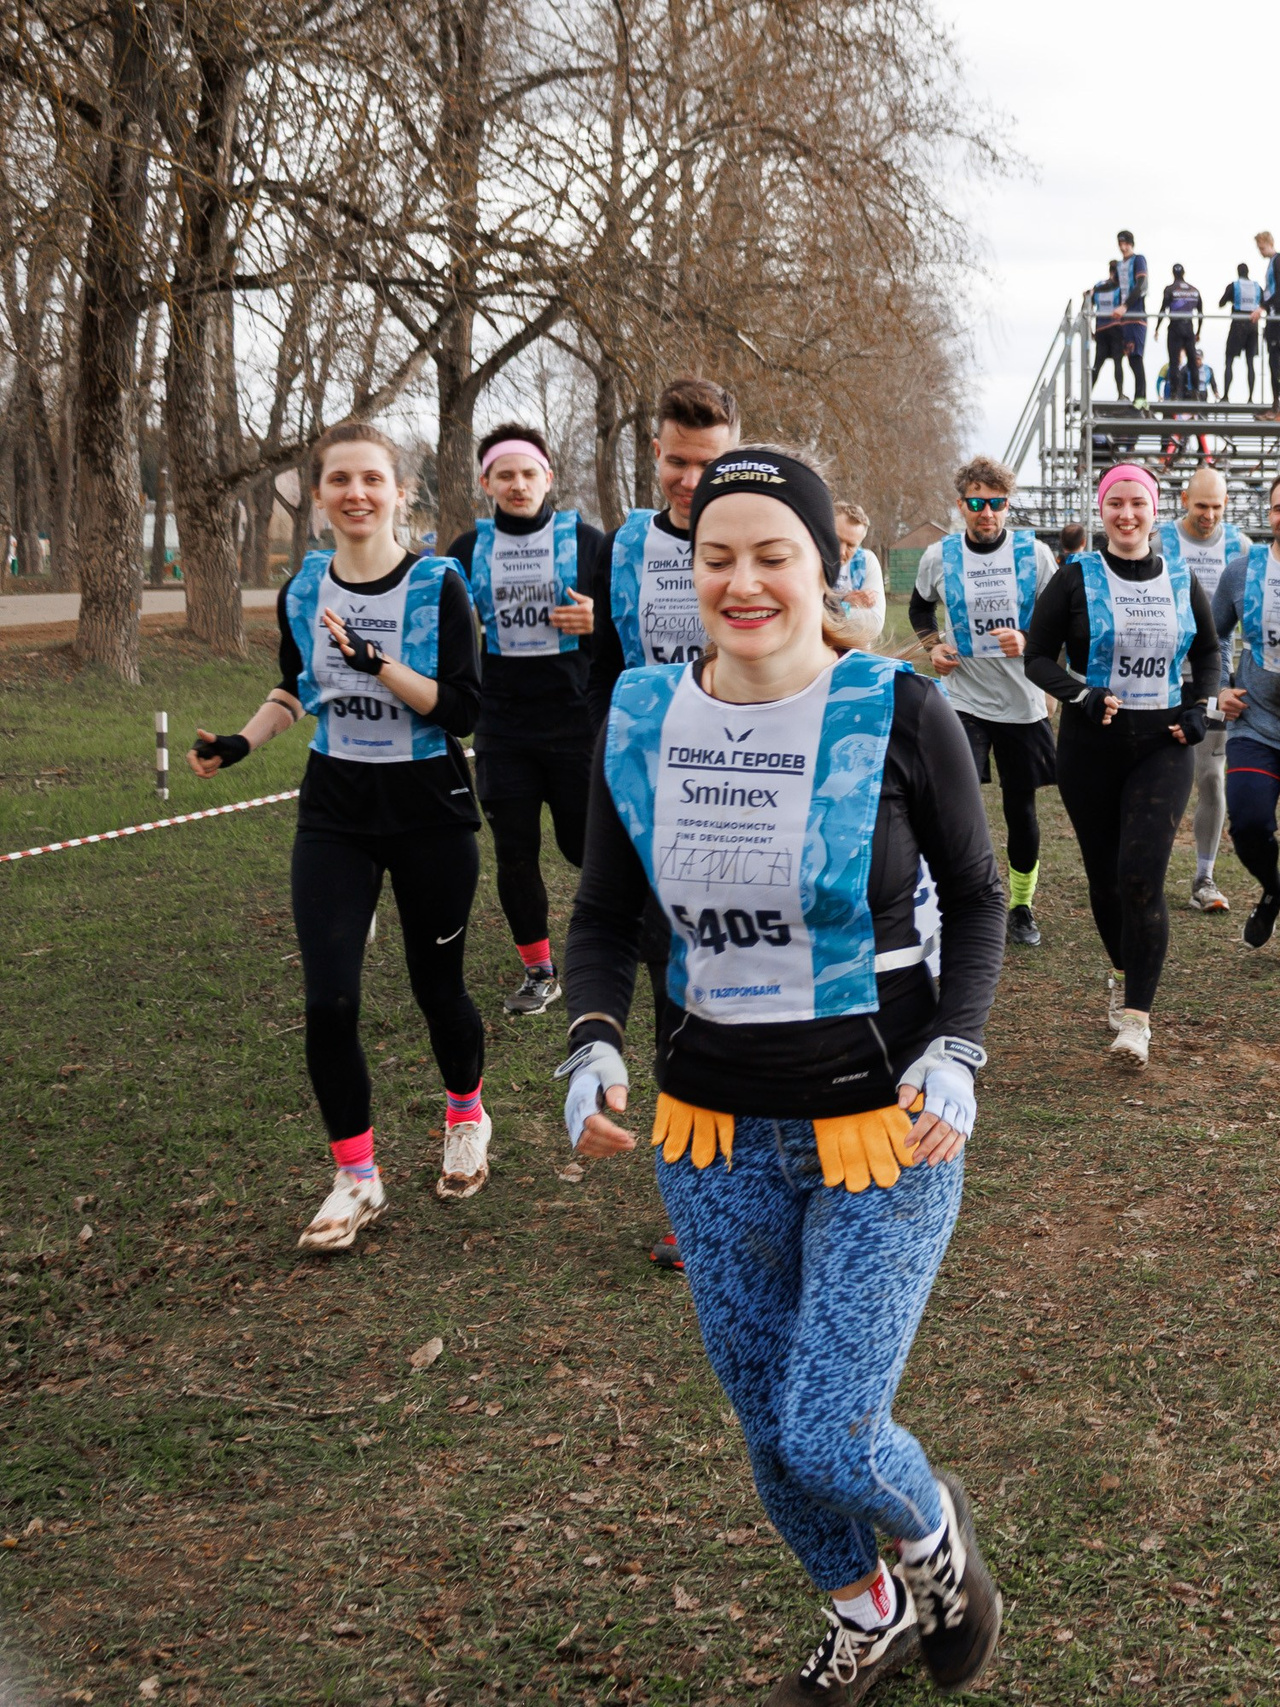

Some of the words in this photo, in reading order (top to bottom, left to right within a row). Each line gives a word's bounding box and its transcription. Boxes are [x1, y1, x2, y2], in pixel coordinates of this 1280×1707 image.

[715, 460, 780, 476] Sminex
[724, 471, 768, 482] team
[503, 561, 541, 572] Sminex
[648, 560, 678, 569] ГОНКА
[1194, 566, 1217, 574] minex
[656, 576, 695, 591] Smin
[974, 579, 1006, 588] Sminex
[500, 606, 551, 628] 5404
[1125, 607, 1166, 618] Sminex
[355, 618, 397, 629] ГЕРОЕВ
[652, 644, 704, 665] 540
[1118, 655, 1166, 679] 5403
[334, 697, 399, 721] 5401
[668, 746, 726, 765] ГОНКА
[731, 751, 806, 769] ГЕРОЕВ
[680, 778, 779, 808] Sminex
[676, 818, 776, 831] ПЕРФЕКЦИОНИСТЫ
[676, 832, 696, 841] FINE
[700, 833, 774, 844] DEVELOPMENT
[671, 904, 792, 955] 5405
[710, 984, 782, 999] ГАЗПРОМБАНК
